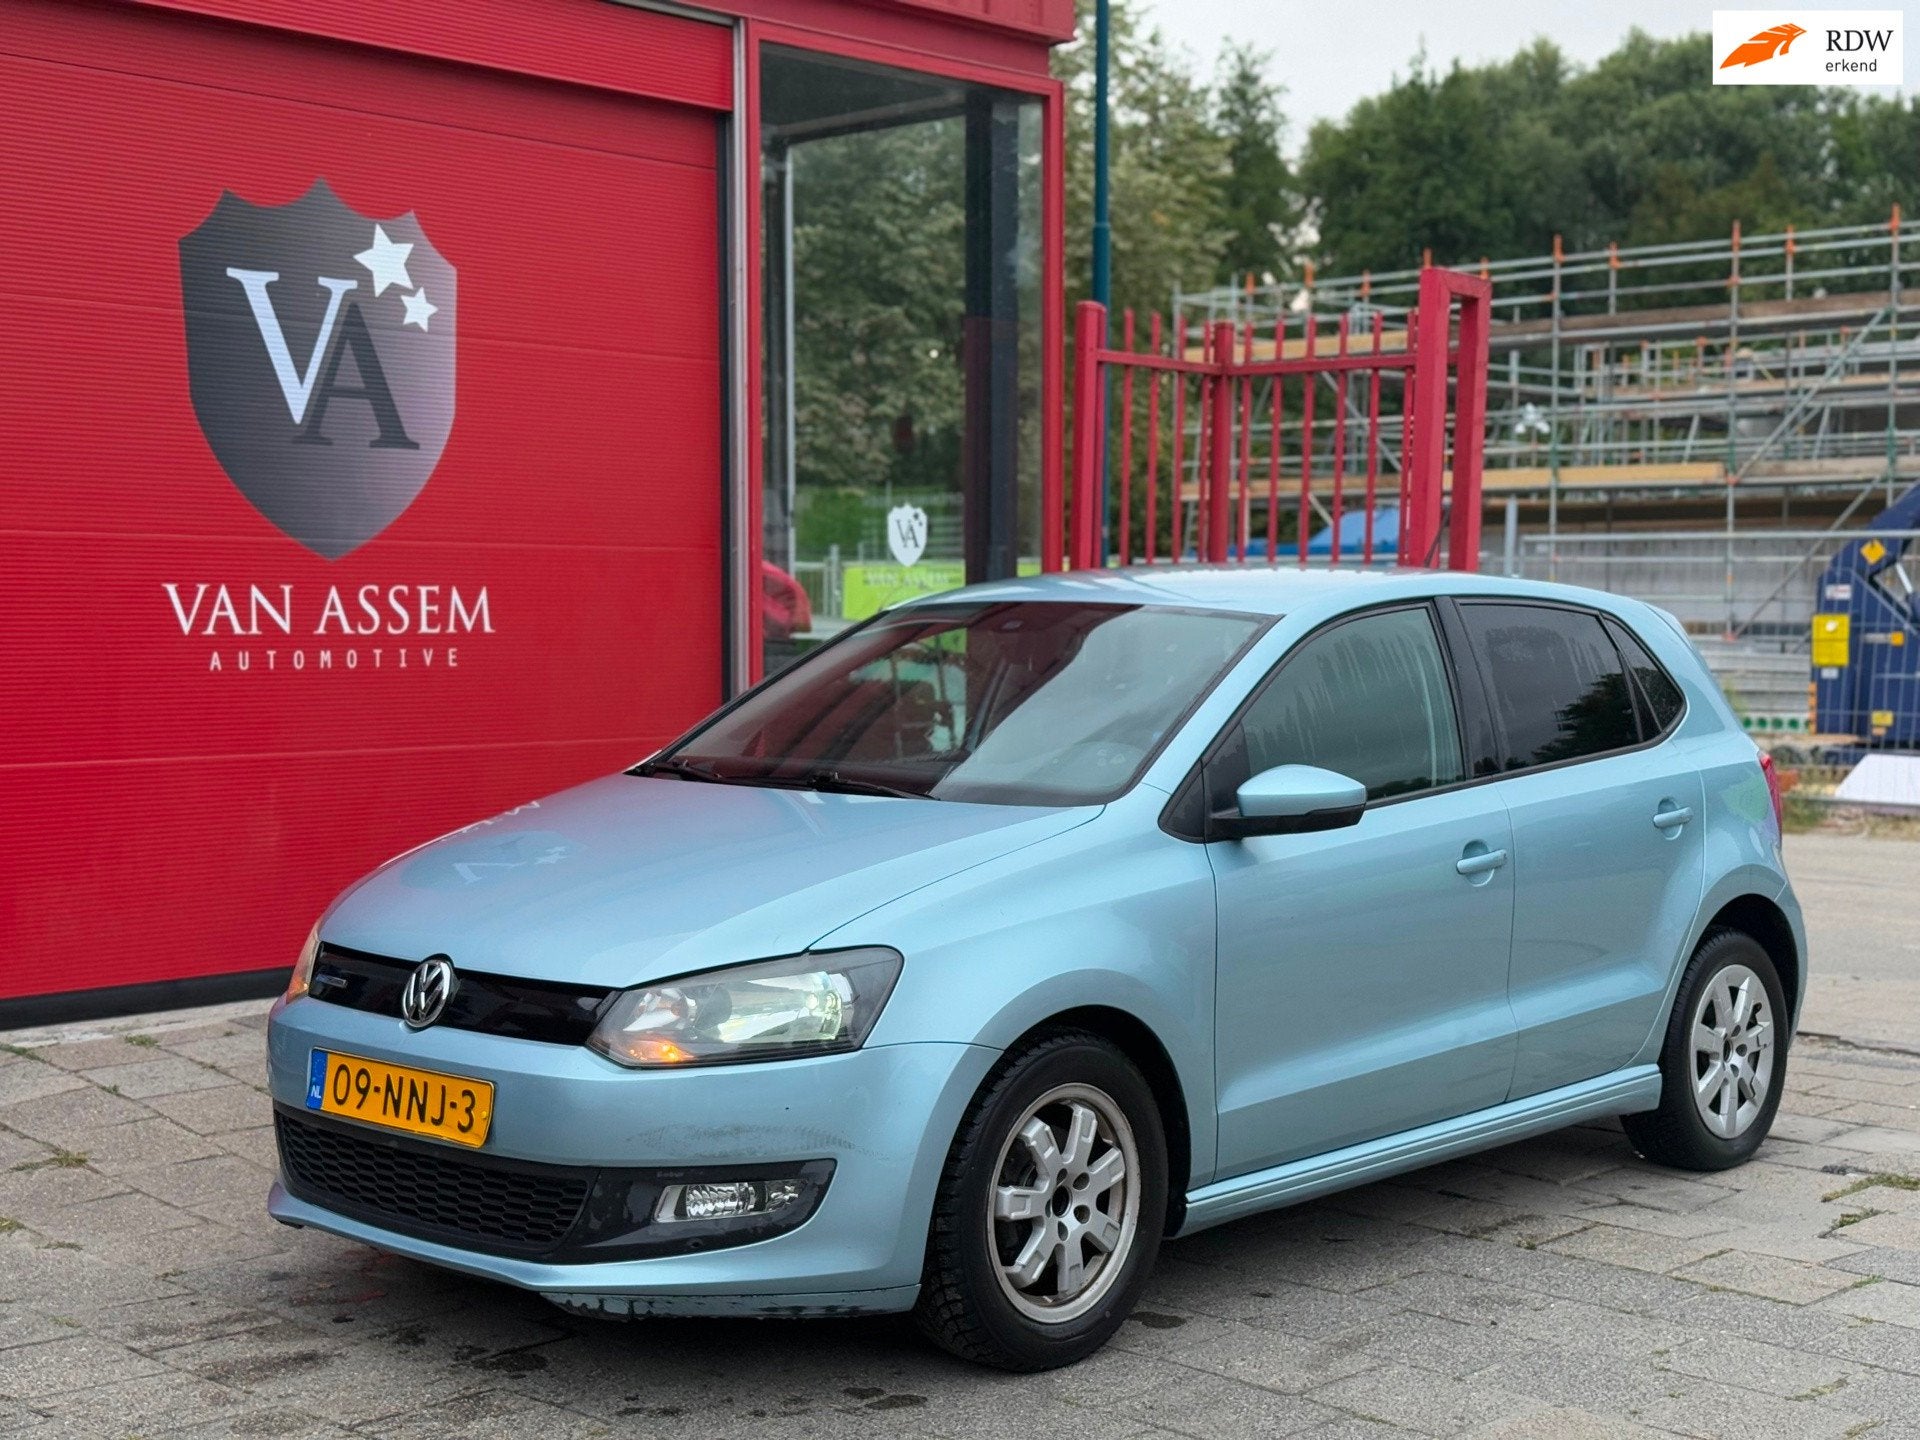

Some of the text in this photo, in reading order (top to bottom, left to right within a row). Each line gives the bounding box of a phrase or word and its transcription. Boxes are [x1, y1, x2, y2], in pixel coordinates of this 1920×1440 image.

[226, 267, 420, 449] VA
[162, 583, 495, 636] VAN ASSEM
[210, 648, 458, 671] AUTOMOTIVE
[310, 1085, 322, 1099] NL
[333, 1063, 476, 1133] 09-NNJ-3
